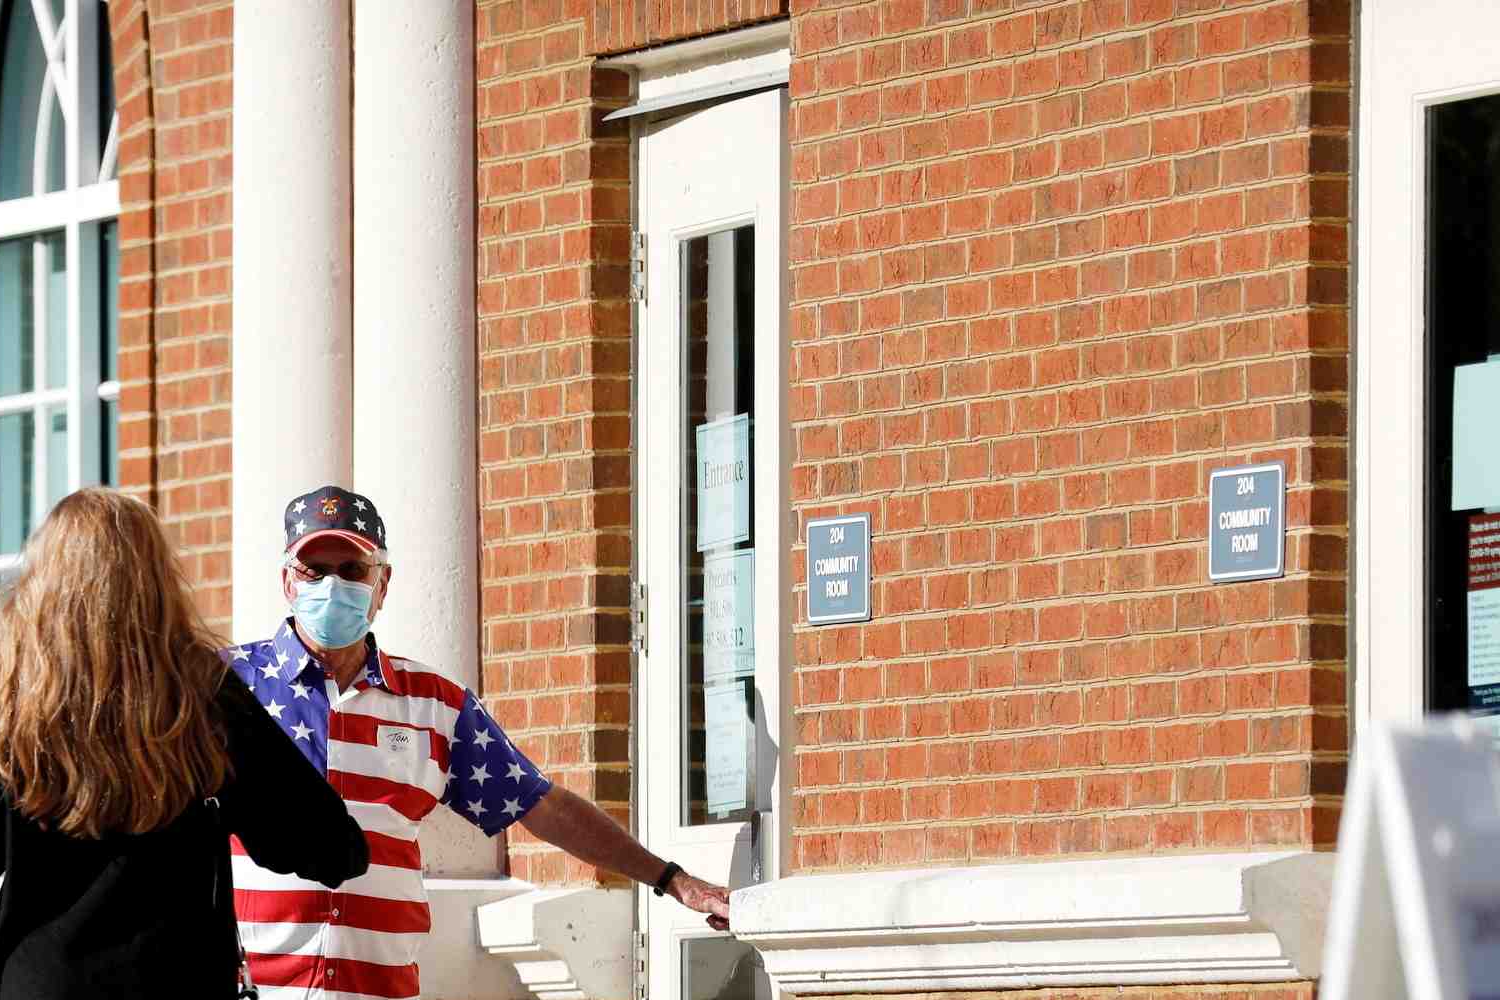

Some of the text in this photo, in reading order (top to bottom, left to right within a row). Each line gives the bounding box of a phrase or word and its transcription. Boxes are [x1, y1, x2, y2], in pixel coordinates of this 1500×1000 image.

[703, 460, 745, 489] Entrance
[1237, 475, 1254, 495] 204
[1219, 506, 1271, 530] COMMUNITY
[829, 526, 845, 544] 204
[1231, 533, 1259, 553] ROOM
[814, 555, 859, 577] COMMUNITY
[825, 579, 849, 598] ROOM
